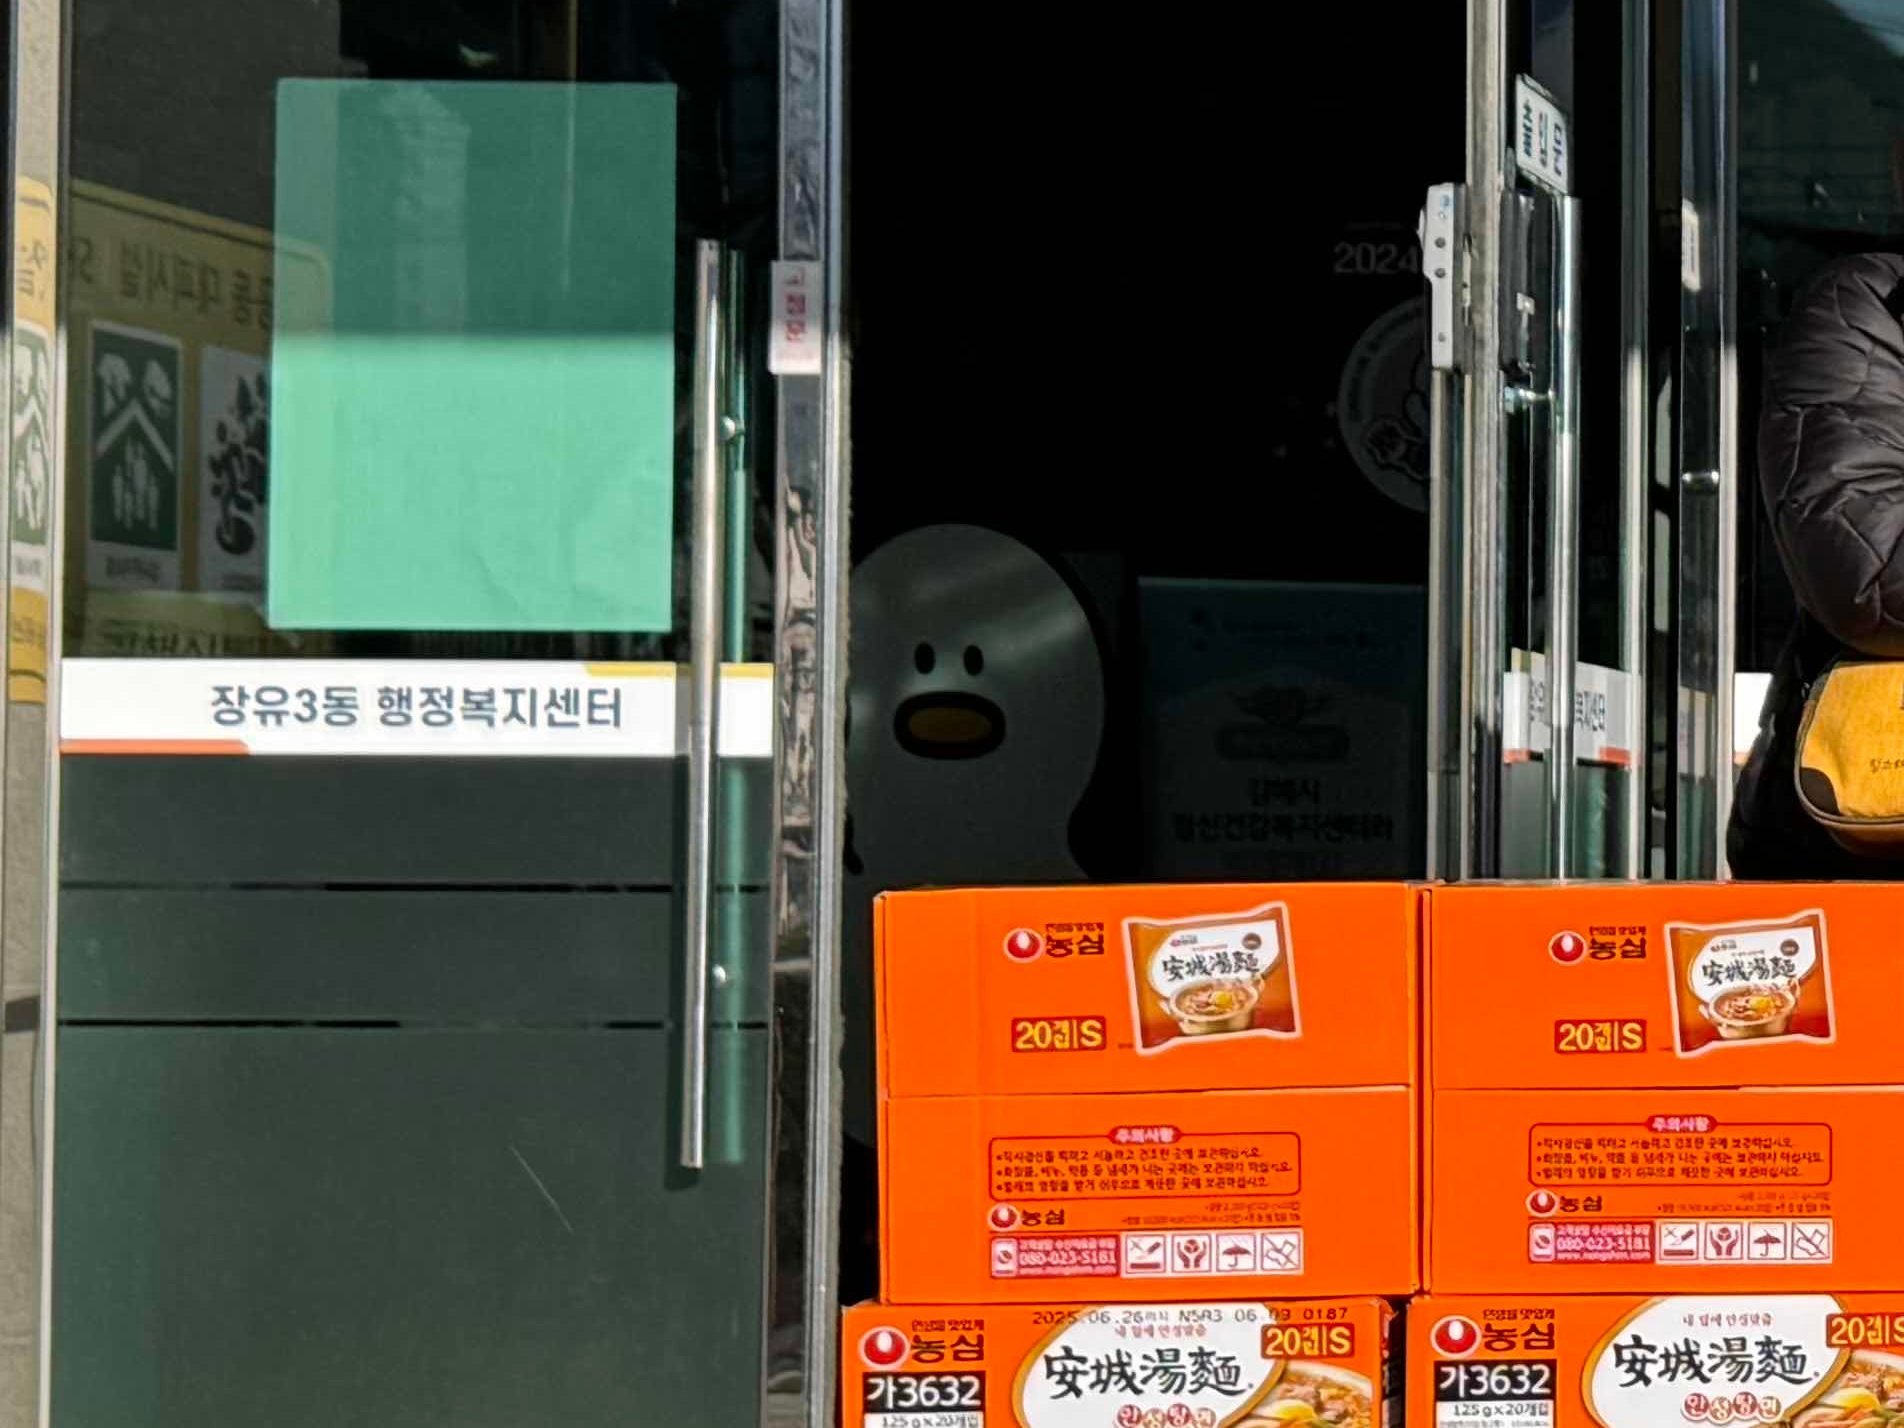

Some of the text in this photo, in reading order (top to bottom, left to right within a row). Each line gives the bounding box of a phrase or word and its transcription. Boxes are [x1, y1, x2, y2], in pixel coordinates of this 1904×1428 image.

[210, 684, 624, 729] 장유3동 행정복지센터
[1046, 934, 1105, 956] 농심
[1590, 937, 1647, 960] 농심
[1559, 1194, 1602, 1213] 농심
[1303, 1308, 1348, 1321] 0187
[910, 1335, 985, 1362] 농심
[1482, 1324, 1556, 1351] 농심
[1044, 1346, 1245, 1400] 安城湯麵
[1613, 1334, 1809, 1388] 安城湯麵
[865, 1377, 982, 1407] 가3632
[1439, 1365, 1551, 1398] 가3632
